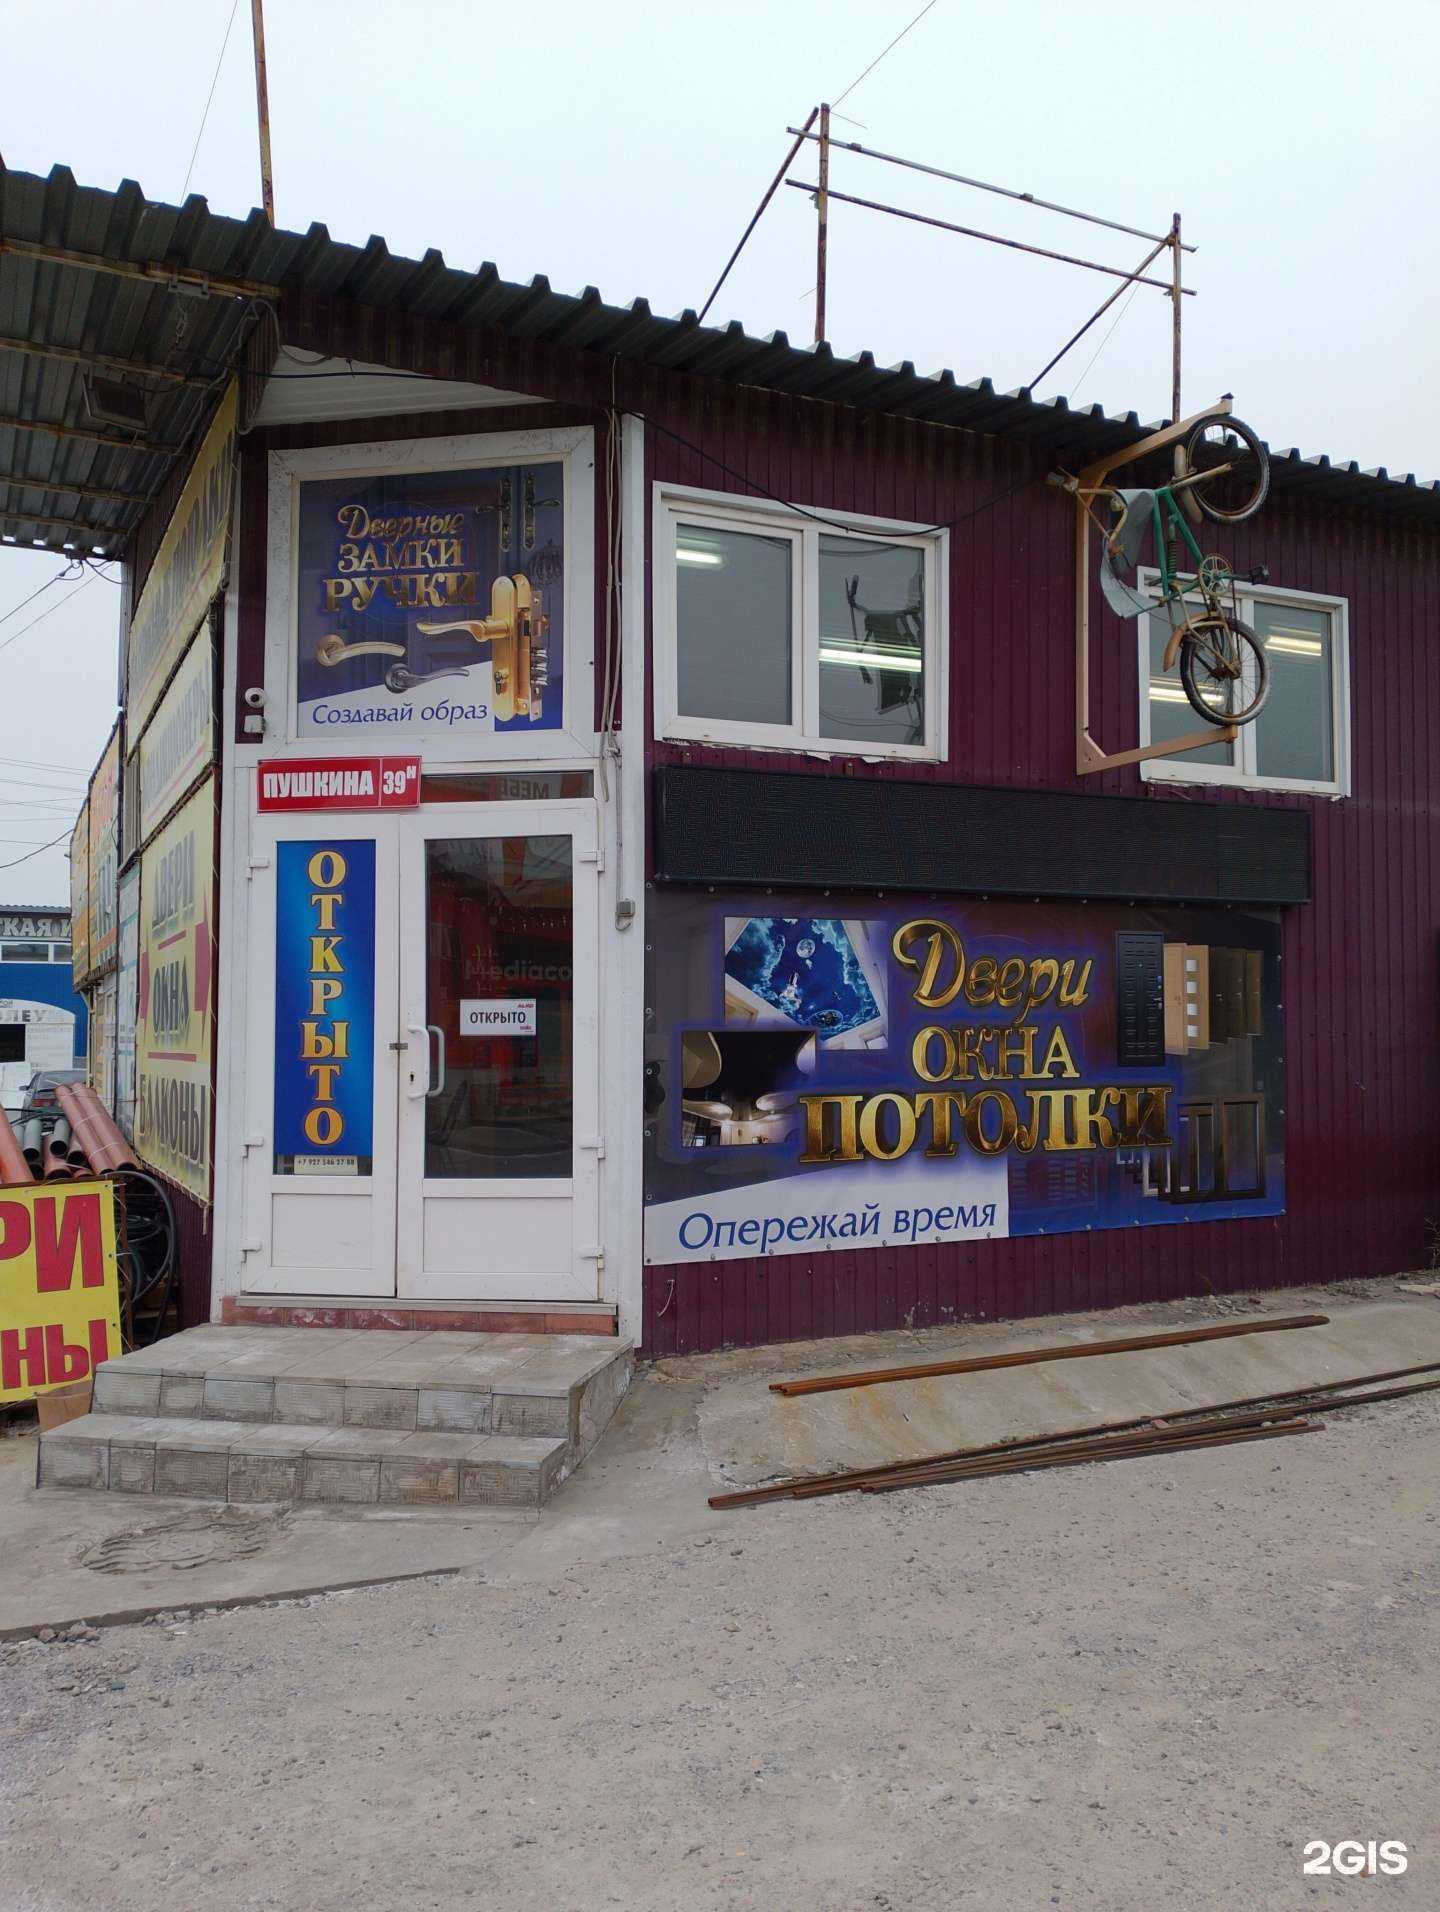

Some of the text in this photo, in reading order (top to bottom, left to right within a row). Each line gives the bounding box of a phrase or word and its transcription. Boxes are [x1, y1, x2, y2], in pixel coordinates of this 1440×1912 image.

[338, 504, 465, 545] Дверные
[338, 538, 465, 573] ЗАМКИ
[322, 572, 480, 612] РУЧКИ
[312, 699, 488, 726] Создавай образ
[263, 771, 374, 798] ПУШКИНА
[152, 829, 195, 929] ДВЕРИ
[0, 917, 52, 937] КАЯ
[152, 955, 190, 1036] ОКНА
[892, 918, 1094, 1024] Двери
[301, 849, 350, 1146] ОТКРЫТО
[470, 1011, 526, 1024] ОТКРЫТО
[912, 1025, 1081, 1082] ОКНА
[140, 1073, 206, 1165] БАЛКОНЫ
[799, 1086, 1174, 1163] ПОТОЛКИ
[678, 1203, 998, 1254] Опережай время
